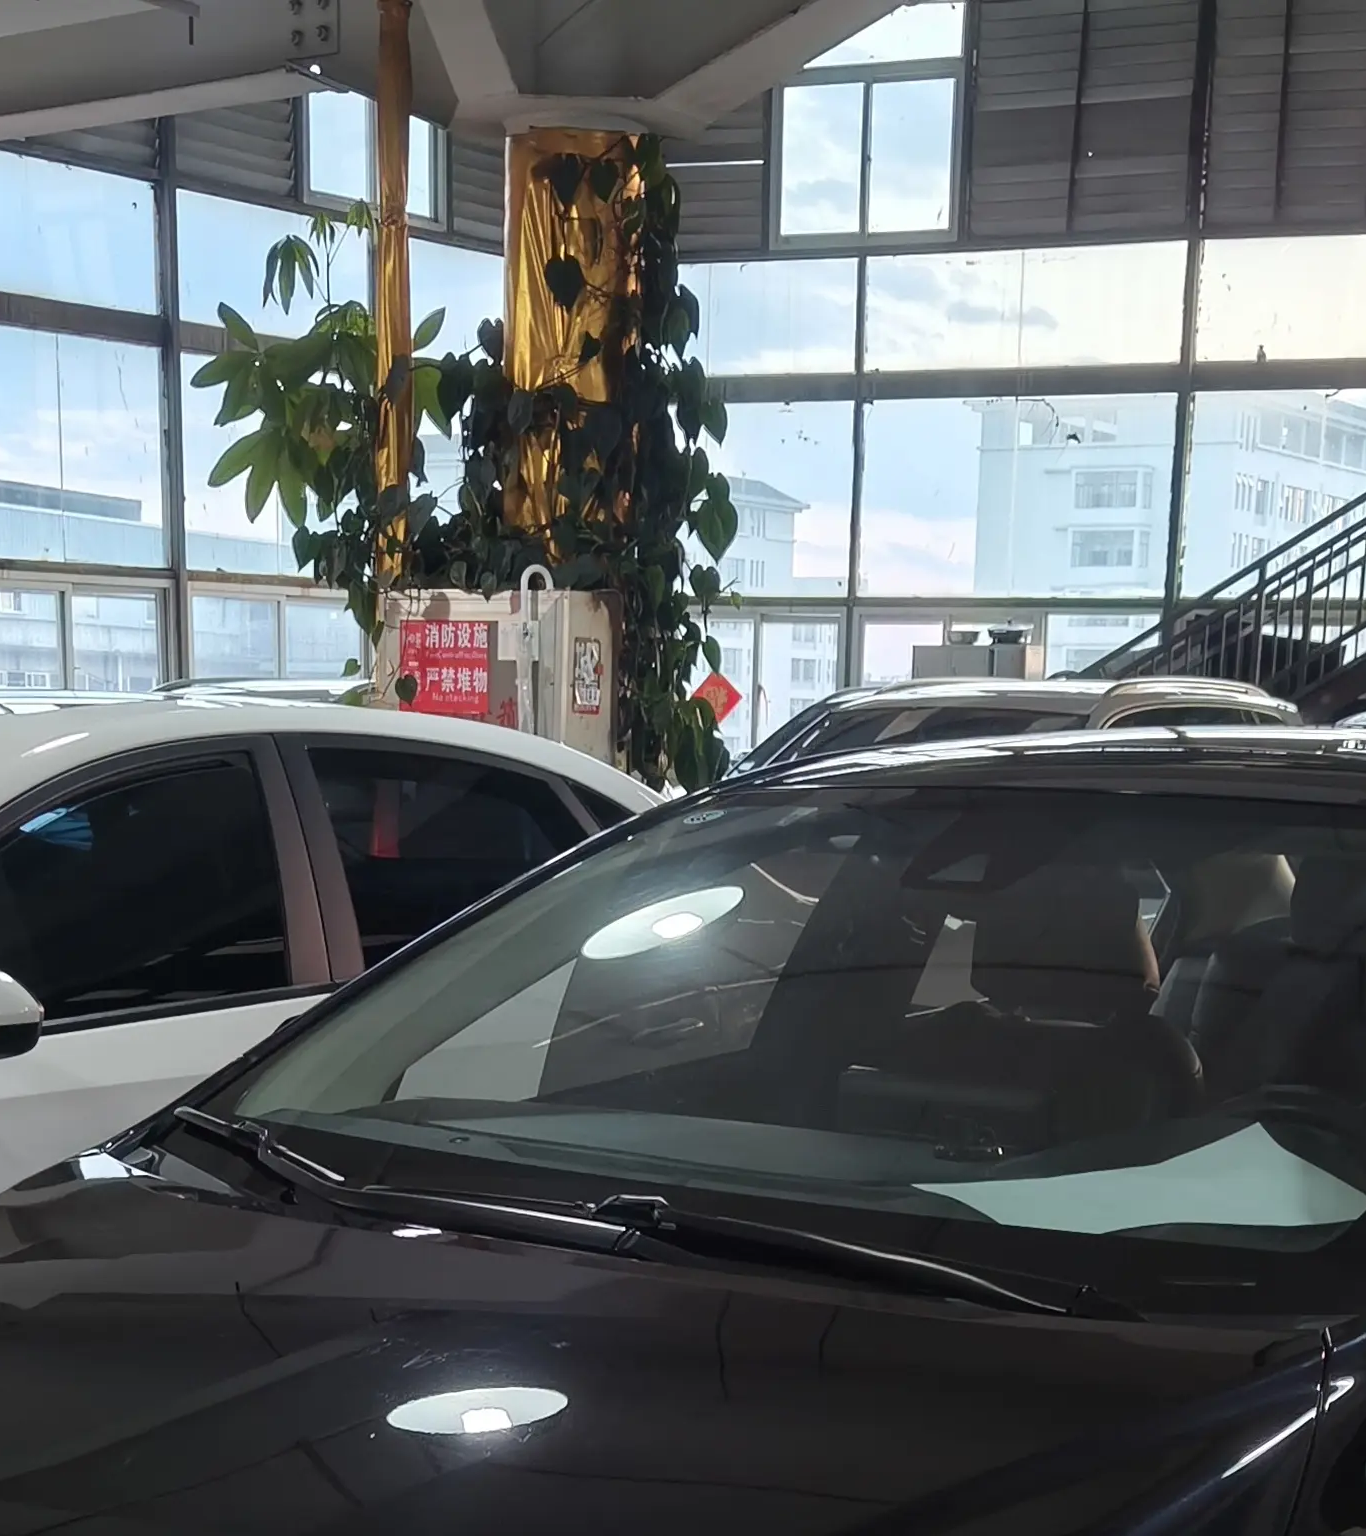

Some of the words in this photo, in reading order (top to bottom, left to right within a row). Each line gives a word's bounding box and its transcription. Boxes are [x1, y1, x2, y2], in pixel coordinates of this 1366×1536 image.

[425, 622, 488, 648] 消防设施
[425, 667, 488, 693] 严禁堆物
